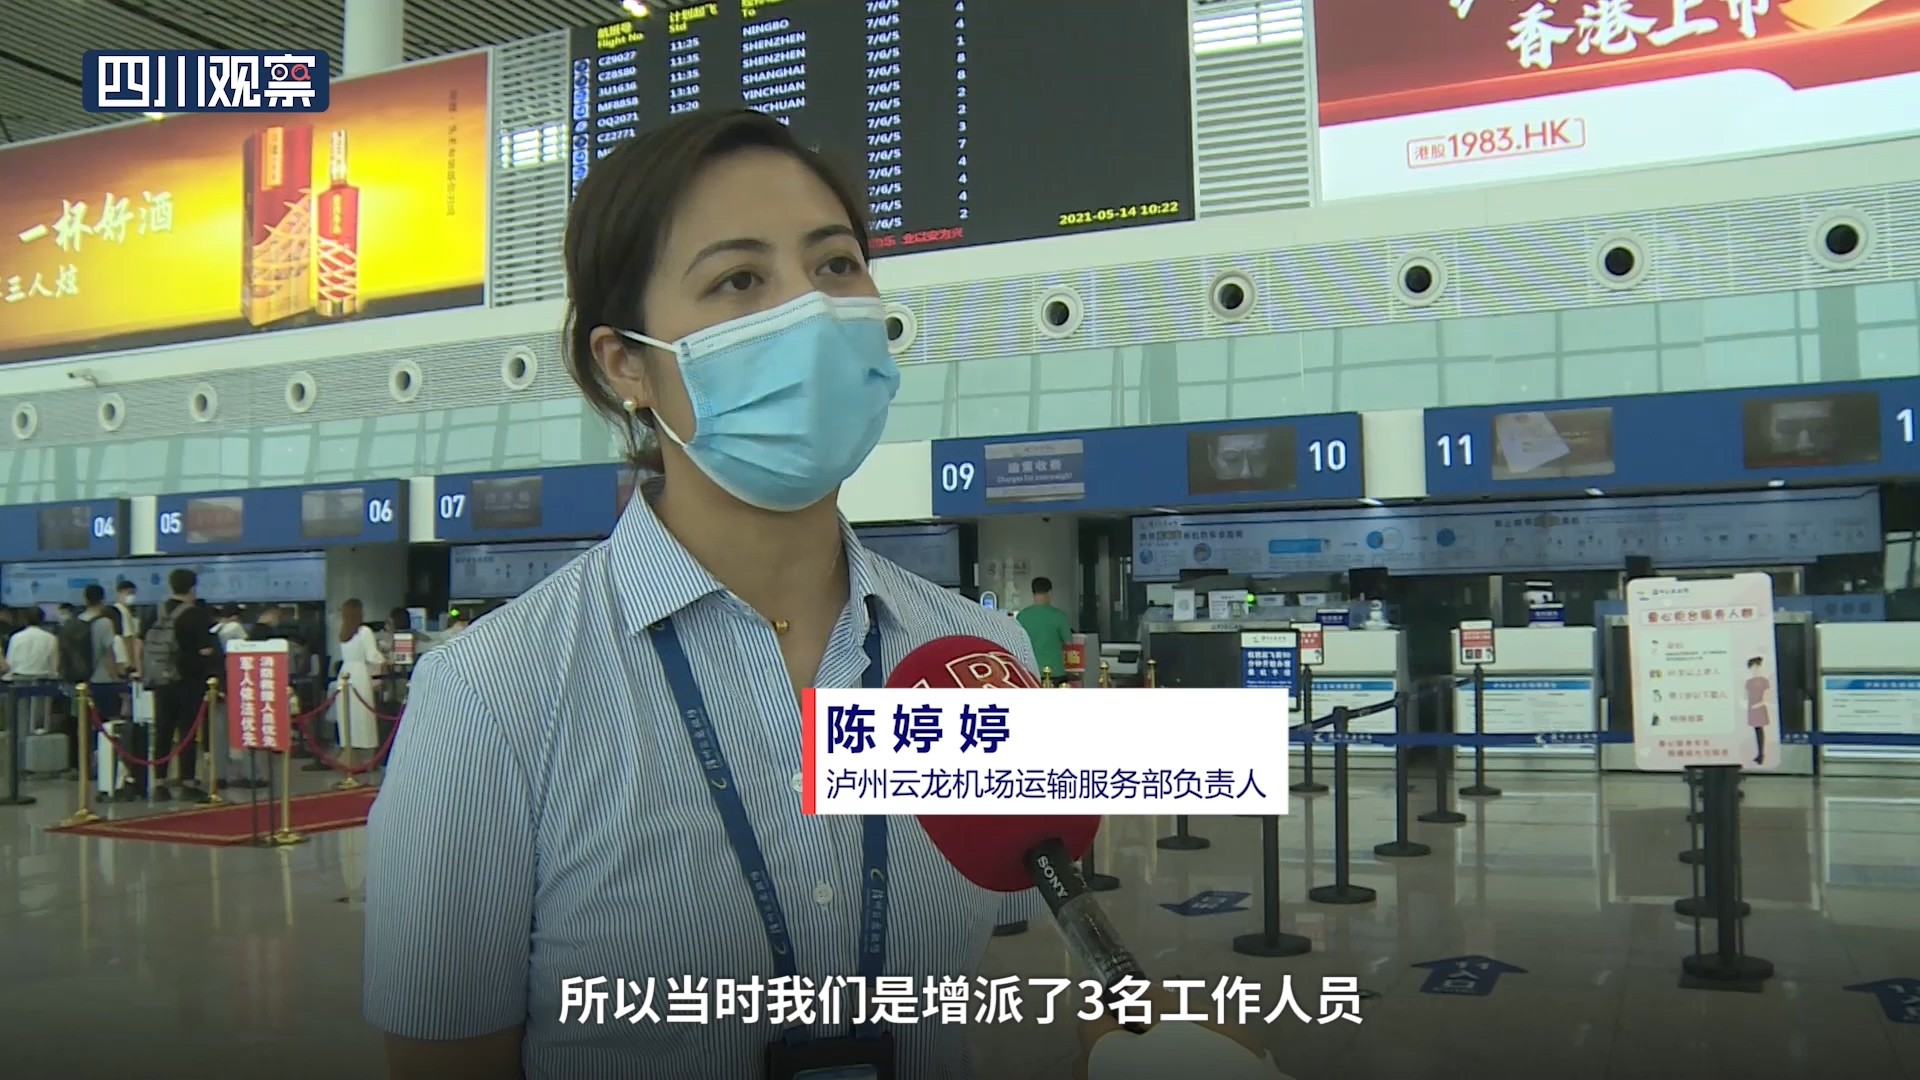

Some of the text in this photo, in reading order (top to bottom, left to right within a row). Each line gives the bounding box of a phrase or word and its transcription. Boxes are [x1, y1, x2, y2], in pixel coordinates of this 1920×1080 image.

[741, 9, 756, 18] To
[669, 22, 687, 34] Std
[671, 37, 700, 51] 11:25
[742, 19, 789, 37] NINGBO
[742, 32, 806, 53] SHENZHEN
[867, 13, 900, 28] 7/6/5
[955, 2, 964, 11] 4
[598, 32, 644, 49] Flight No
[742, 48, 806, 69] SHENZHEN
[867, 30, 900, 45] 7/6/5
[956, 18, 965, 28] 4
[742, 65, 806, 84] SHANGHAI
[867, 47, 900, 62] 7/6/5
[957, 35, 965, 46] 1
[597, 111, 639, 127] OQ2071
[742, 80, 806, 100] YINCHUAN
[867, 63, 900, 78] 7/6/5
[957, 52, 966, 63] 8
[867, 86, 966, 111] 7/6/5 2
[597, 128, 636, 143] CZ2771
[867, 80, 900, 95] 7/6/5
[957, 69, 966, 80] 8
[868, 103, 966, 128] 7/6/5 2
[868, 121, 967, 145] 7/6/5 3
[1447, 119, 1570, 158] 1983.HK
[868, 138, 967, 162] 7/6/5 7
[1414, 141, 1445, 161] 港股
[868, 155, 967, 179] 7/6/5 4
[868, 173, 967, 196] 7/6/5 4
[868, 190, 968, 213] 7/6/5 4
[959, 207, 969, 219] 2
[1059, 201, 1179, 226] 2021-05-14 10:22
[18, 191, 173, 253] 一杯好酒
[0, 264, 79, 302] 三人炫
[1308, 440, 1346, 472] 10
[1436, 433, 1473, 467] 11
[940, 461, 976, 493] 09
[369, 498, 393, 523] 06
[440, 494, 466, 519] 07
[94, 516, 116, 538] 04
[160, 511, 182, 534] 05
[1037, 855, 1069, 899] SONY
